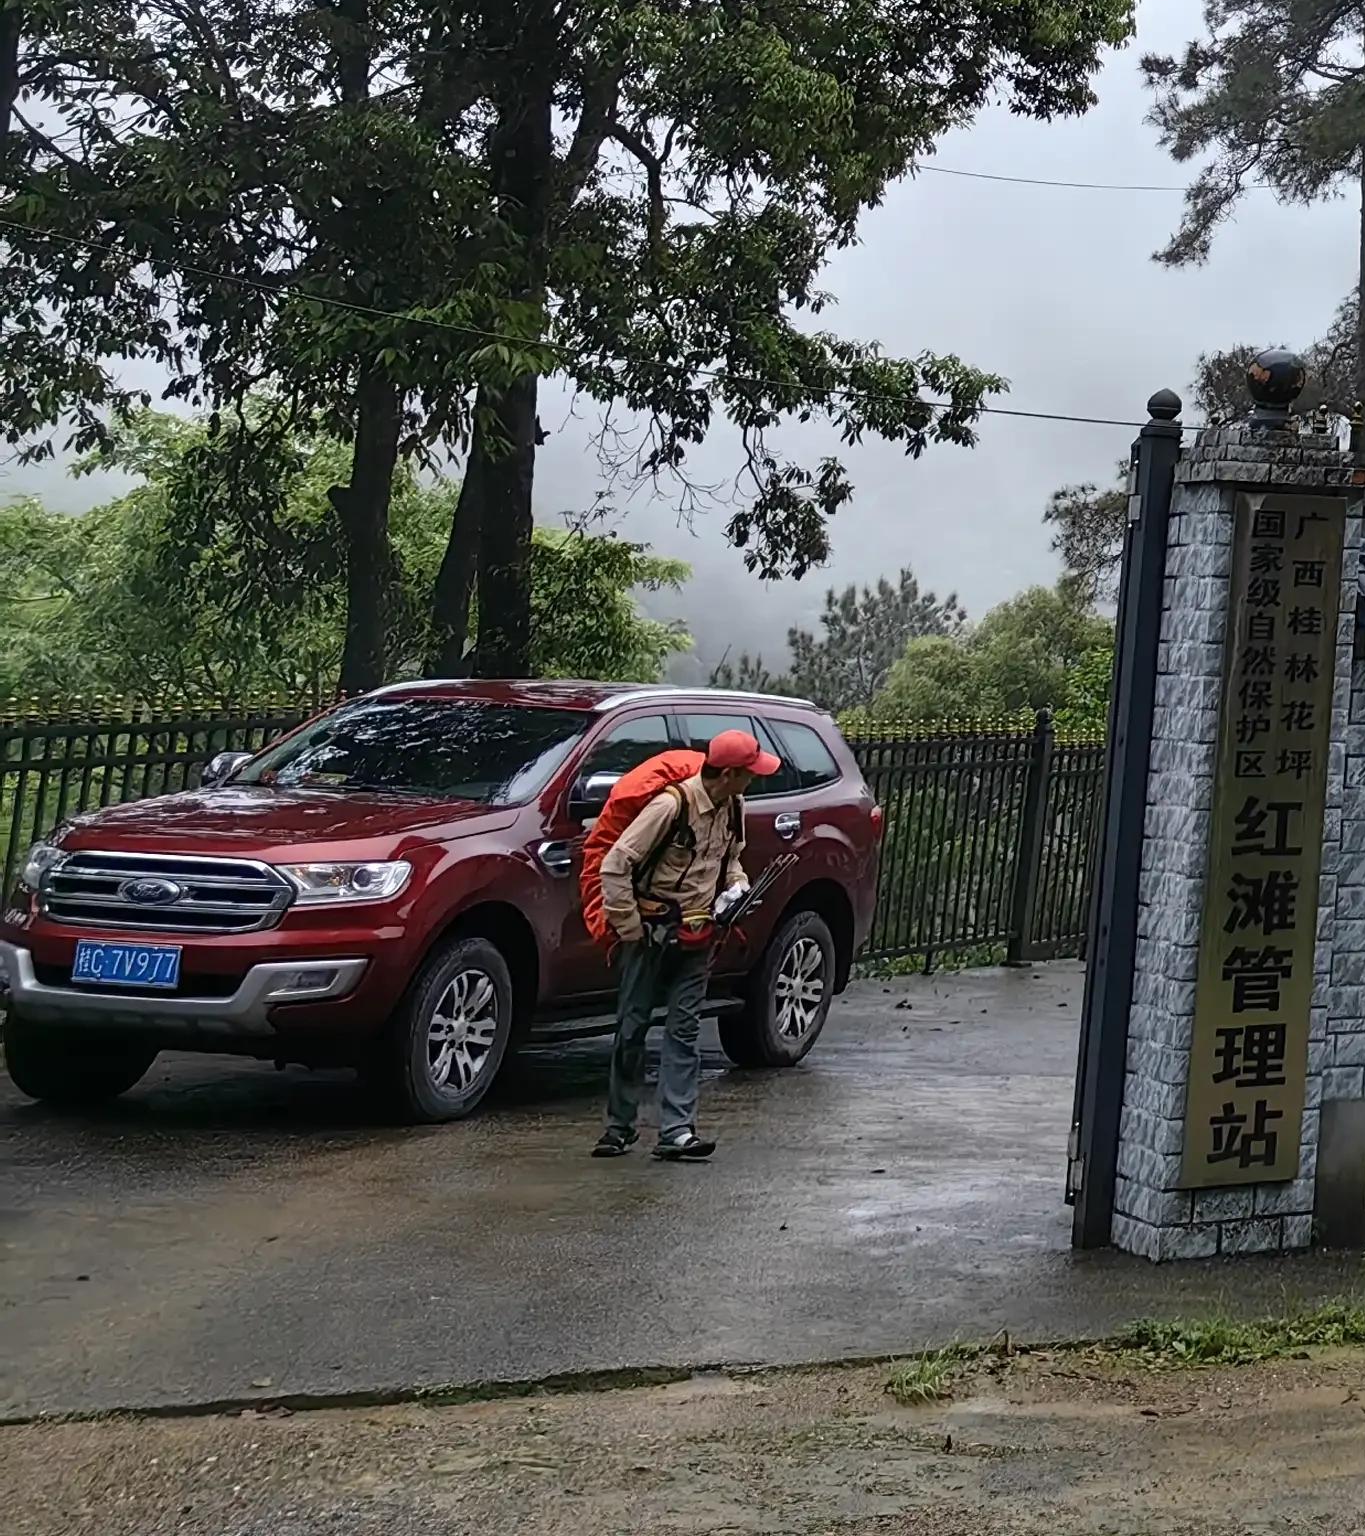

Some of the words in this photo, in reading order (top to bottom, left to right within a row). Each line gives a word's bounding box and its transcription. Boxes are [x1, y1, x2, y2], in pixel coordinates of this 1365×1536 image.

[1234, 509, 1285, 779] 国家级自然保护区
[1275, 509, 1329, 781] 广西桂林花坪
[1206, 795, 1303, 1169] 红滩管理站
